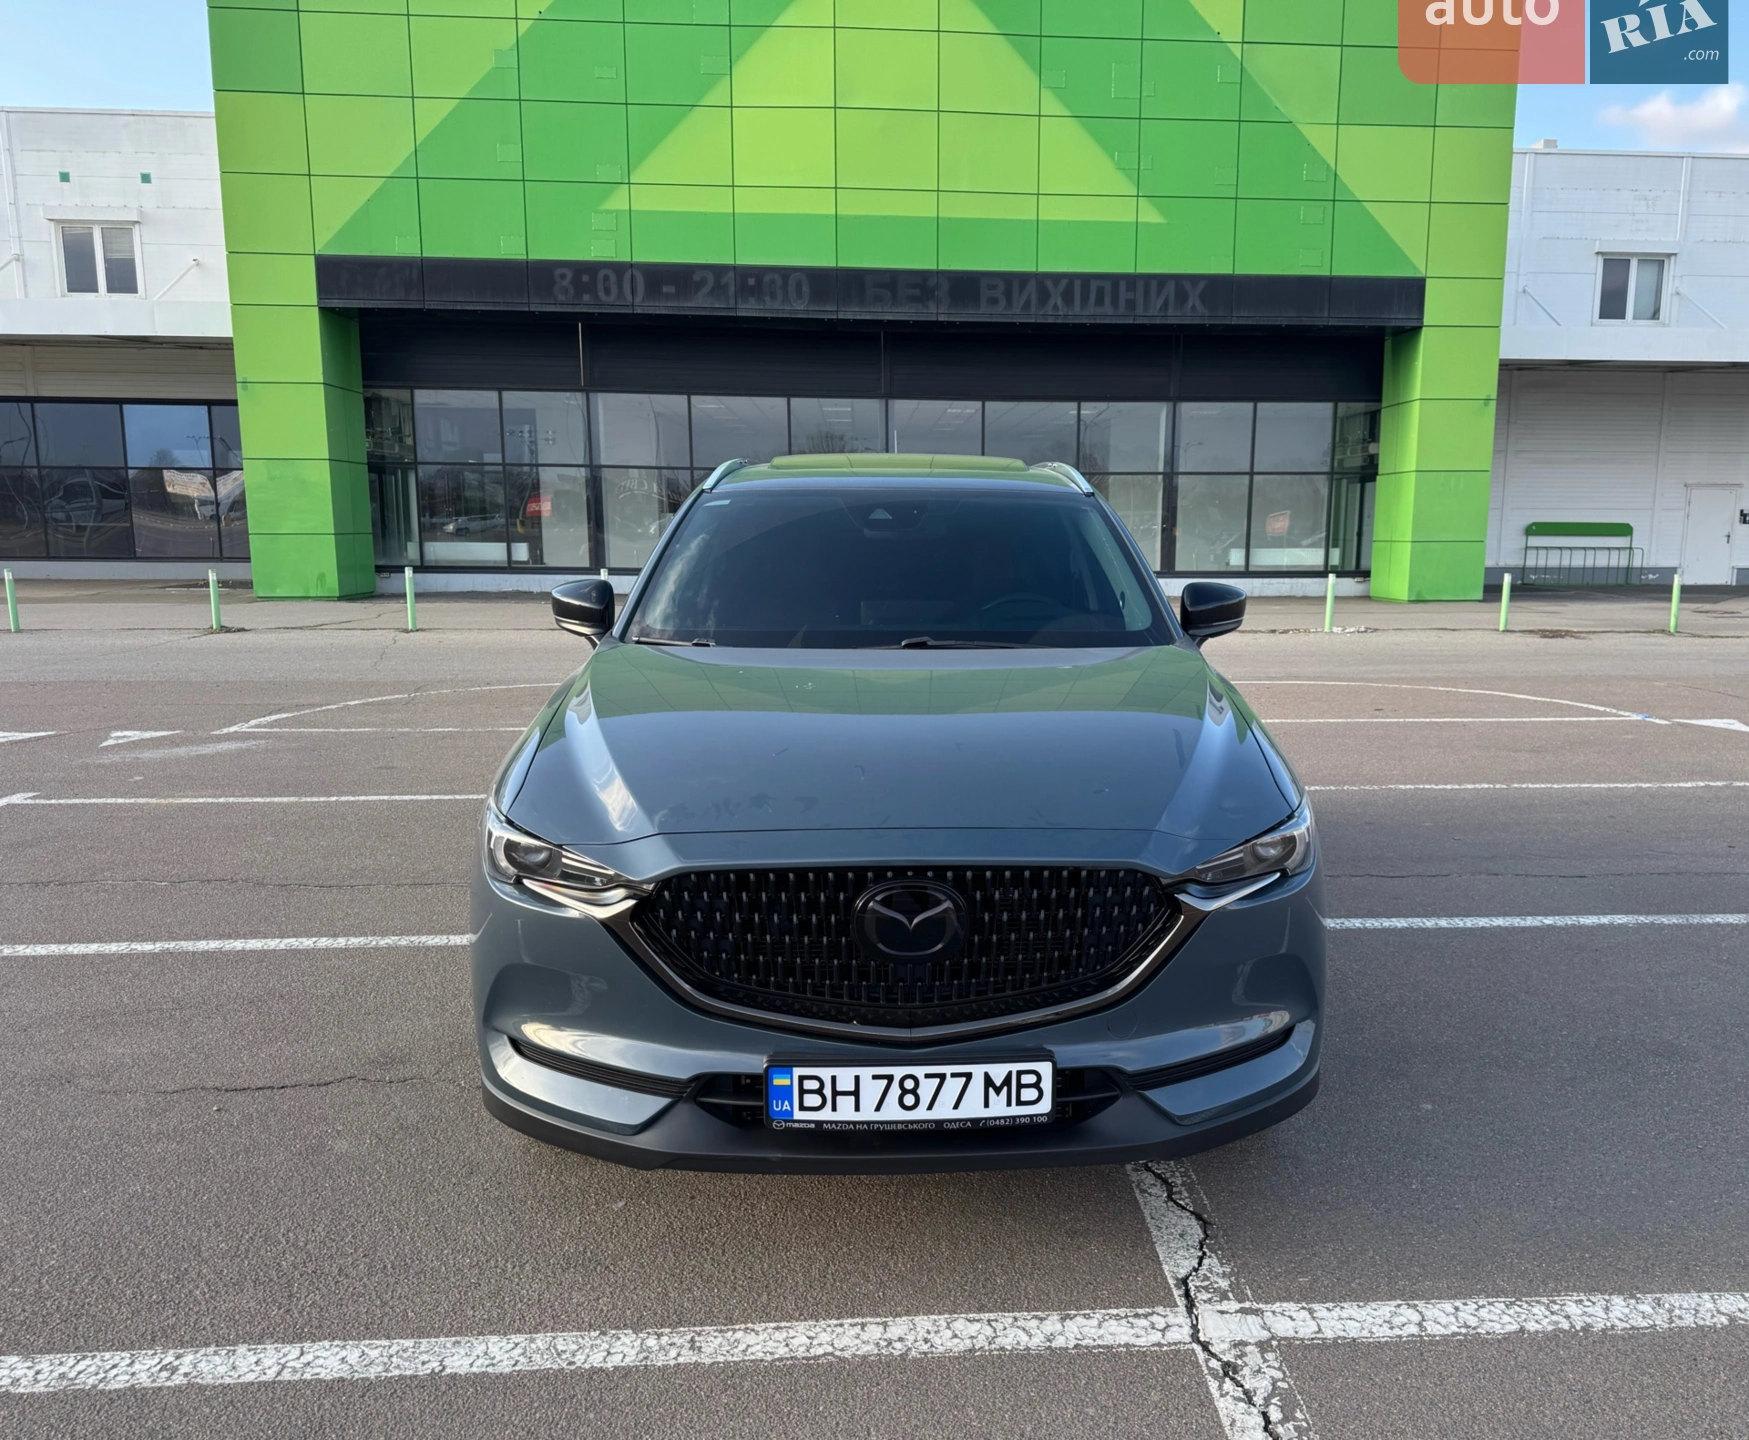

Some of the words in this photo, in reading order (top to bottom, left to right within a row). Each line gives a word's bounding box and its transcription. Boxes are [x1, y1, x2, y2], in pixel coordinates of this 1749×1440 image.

[864, 273, 951, 313] БЕЗ
[979, 276, 1209, 317] ВИХІДНИХ
[797, 1074, 861, 1113] BH
[871, 1071, 973, 1112] 7877
[983, 1069, 1044, 1109] MB
[772, 1099, 791, 1112] UA
[786, 1121, 816, 1129] mazda
[822, 1122, 855, 1130] MAZDA
[856, 1122, 869, 1130] НА
[870, 1122, 936, 1131] ГРУШЕВСЬКОГО
[943, 1120, 972, 1129] ОДЕСА
[986, 1117, 1013, 1128] (0482)
[1015, 1116, 1031, 1125] 390
[1032, 1115, 1048, 1123] 100
